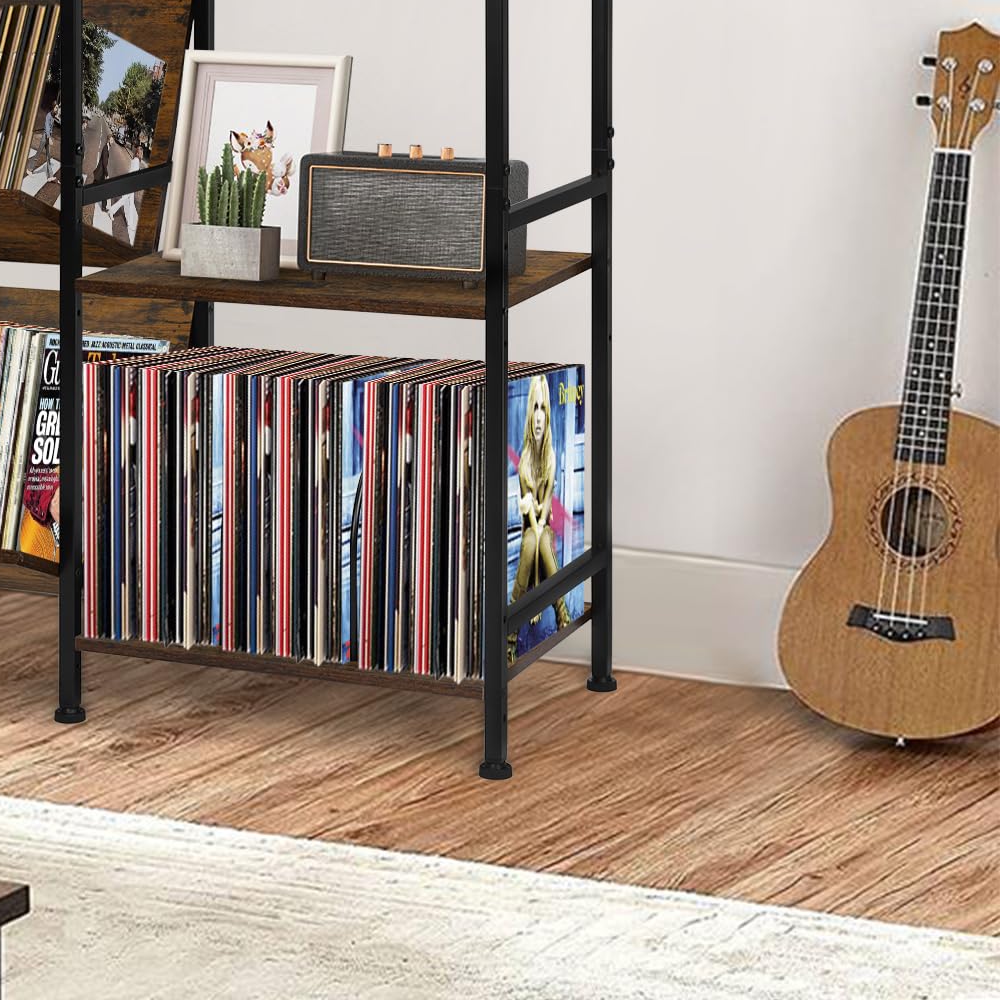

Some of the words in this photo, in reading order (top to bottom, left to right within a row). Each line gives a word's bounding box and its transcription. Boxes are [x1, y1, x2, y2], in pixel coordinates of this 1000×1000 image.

[91, 340, 102, 349] JAZZ
[102, 341, 121, 350] ACOUSTIC
[122, 342, 135, 350] METAL
[136, 343, 157, 351] CLASSICAL
[39, 397, 54, 410] HOW
